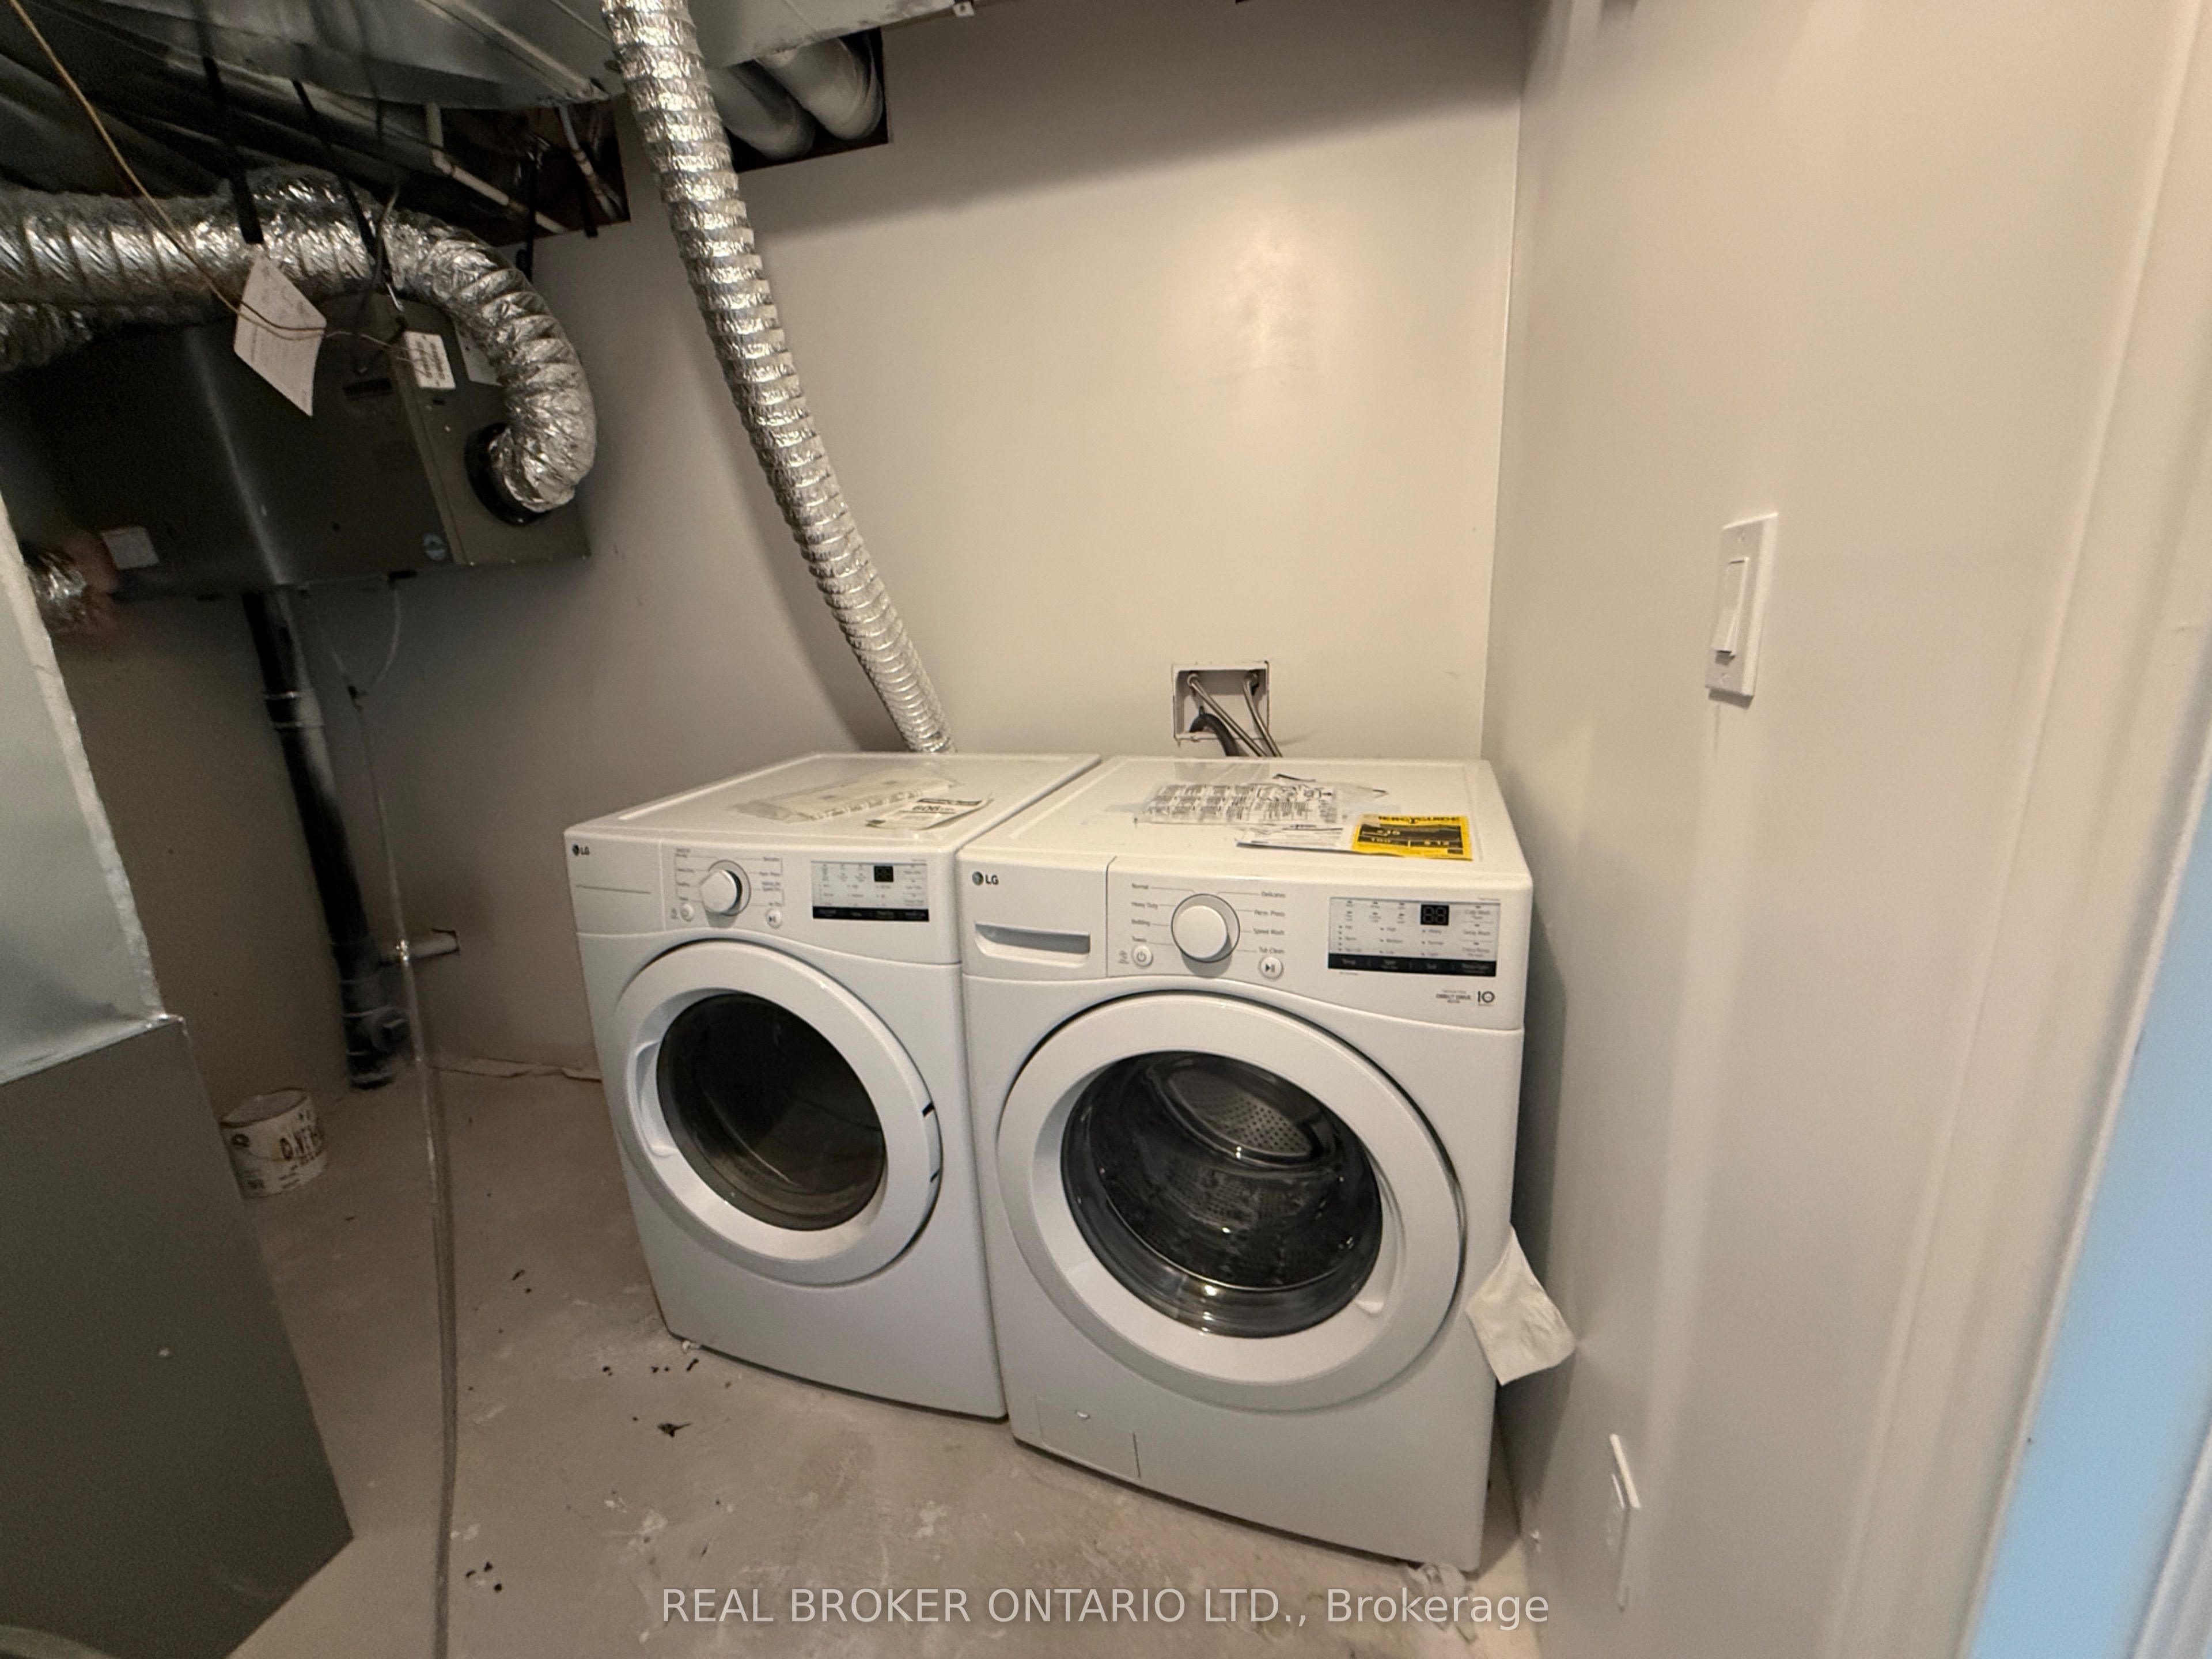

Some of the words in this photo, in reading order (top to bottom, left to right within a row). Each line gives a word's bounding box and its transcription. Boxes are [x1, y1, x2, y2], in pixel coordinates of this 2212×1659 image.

[581, 846, 590, 855] LG
[985, 874, 999, 885] LG
[1477, 990, 1495, 1003] 10
